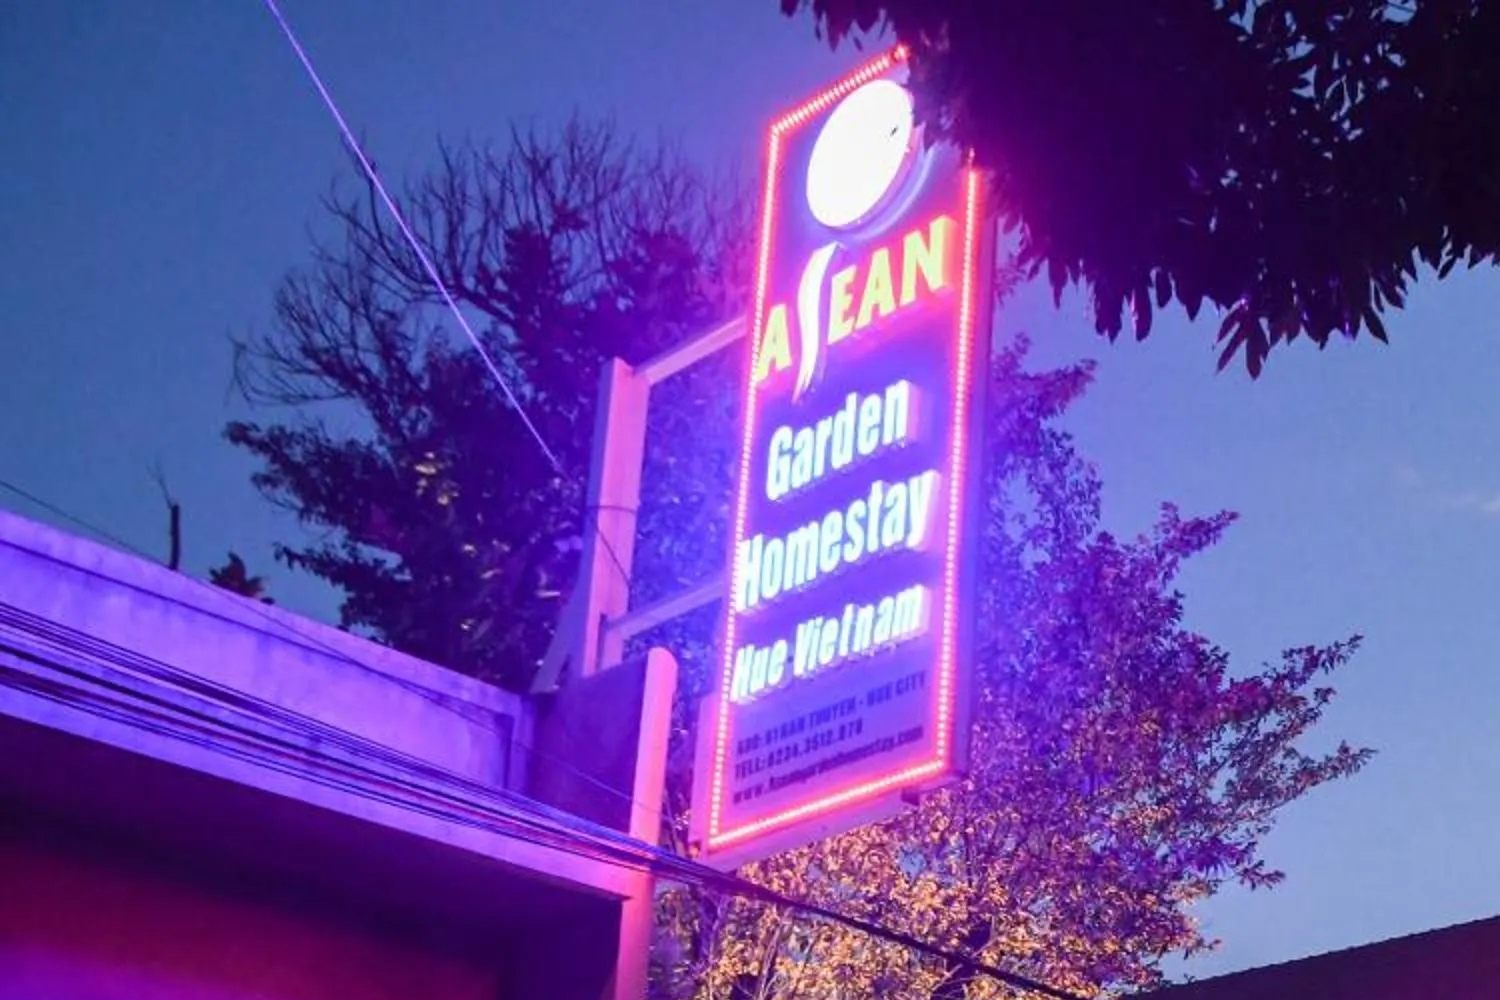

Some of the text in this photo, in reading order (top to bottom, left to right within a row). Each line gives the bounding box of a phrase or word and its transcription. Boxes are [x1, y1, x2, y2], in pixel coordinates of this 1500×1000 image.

[755, 216, 948, 403] ASEAN
[766, 379, 910, 500] Garden
[735, 469, 938, 612] Homestay
[731, 583, 924, 702] Hue Vietnam
